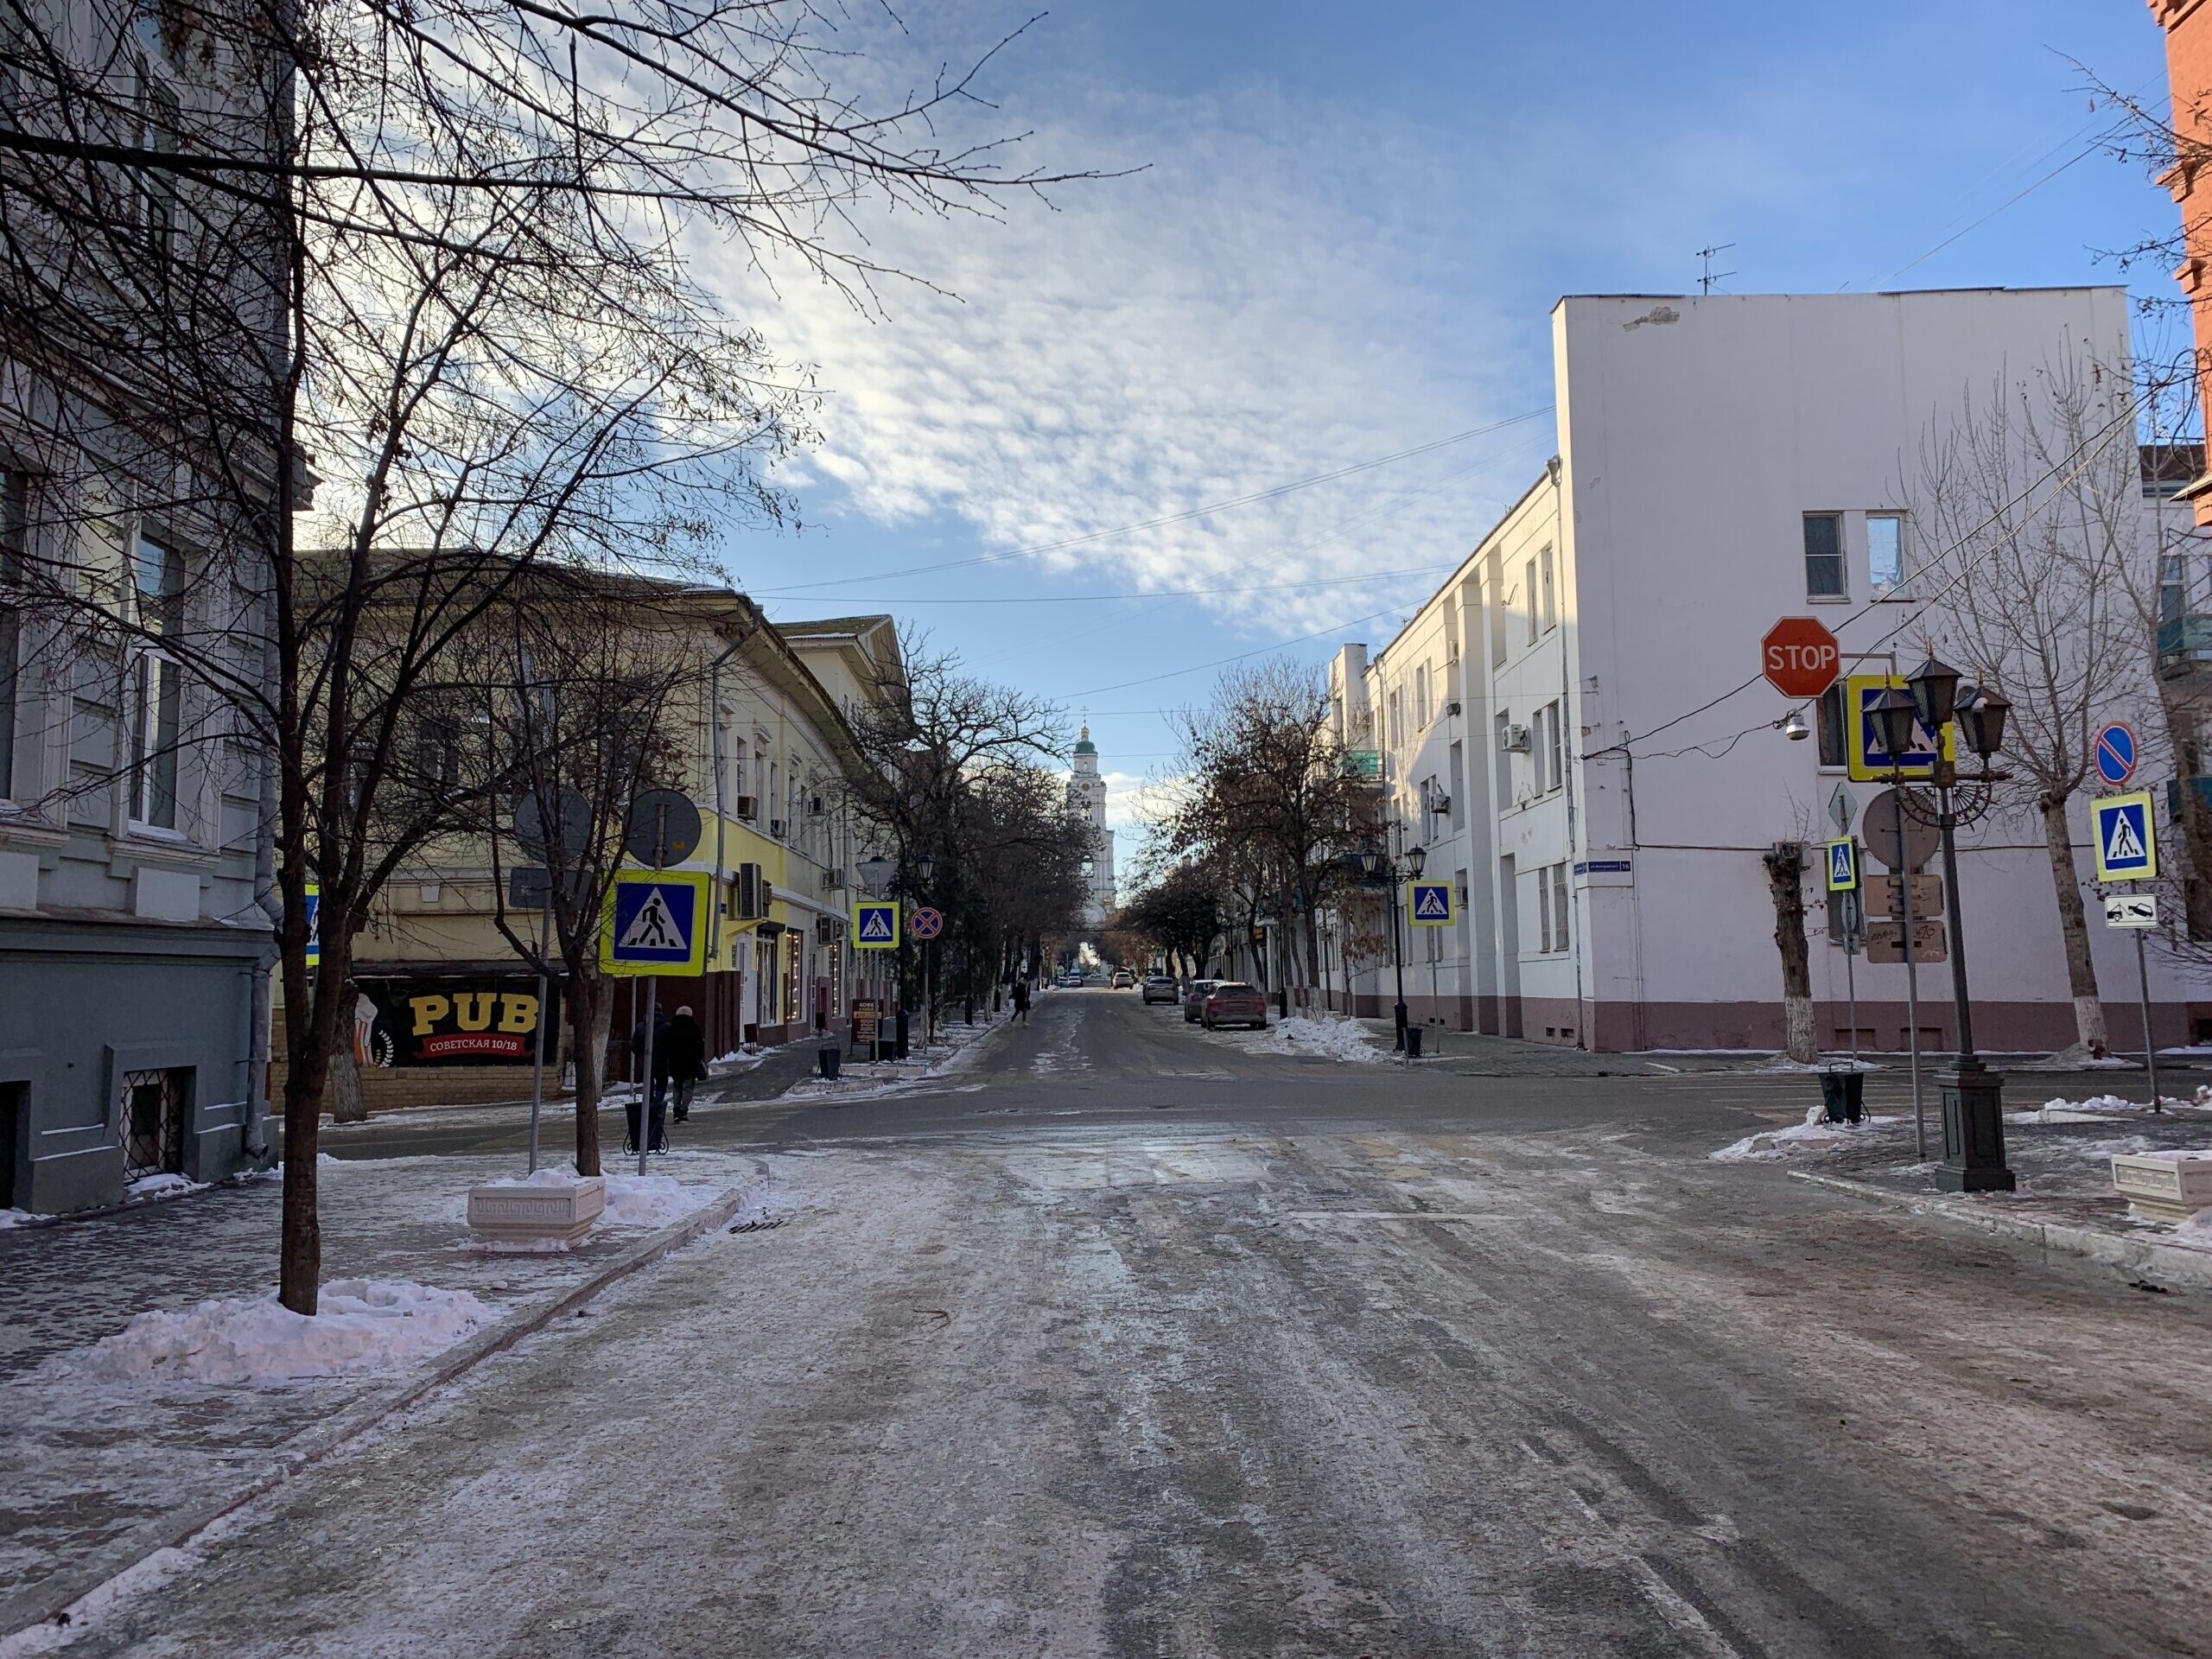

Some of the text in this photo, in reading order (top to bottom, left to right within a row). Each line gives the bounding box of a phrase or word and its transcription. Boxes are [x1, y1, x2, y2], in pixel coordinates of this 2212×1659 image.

[1768, 645, 1836, 671] STOP
[409, 992, 540, 1037] PUB
[429, 1039, 518, 1052] СОВЕТСКАЯ 10/18
